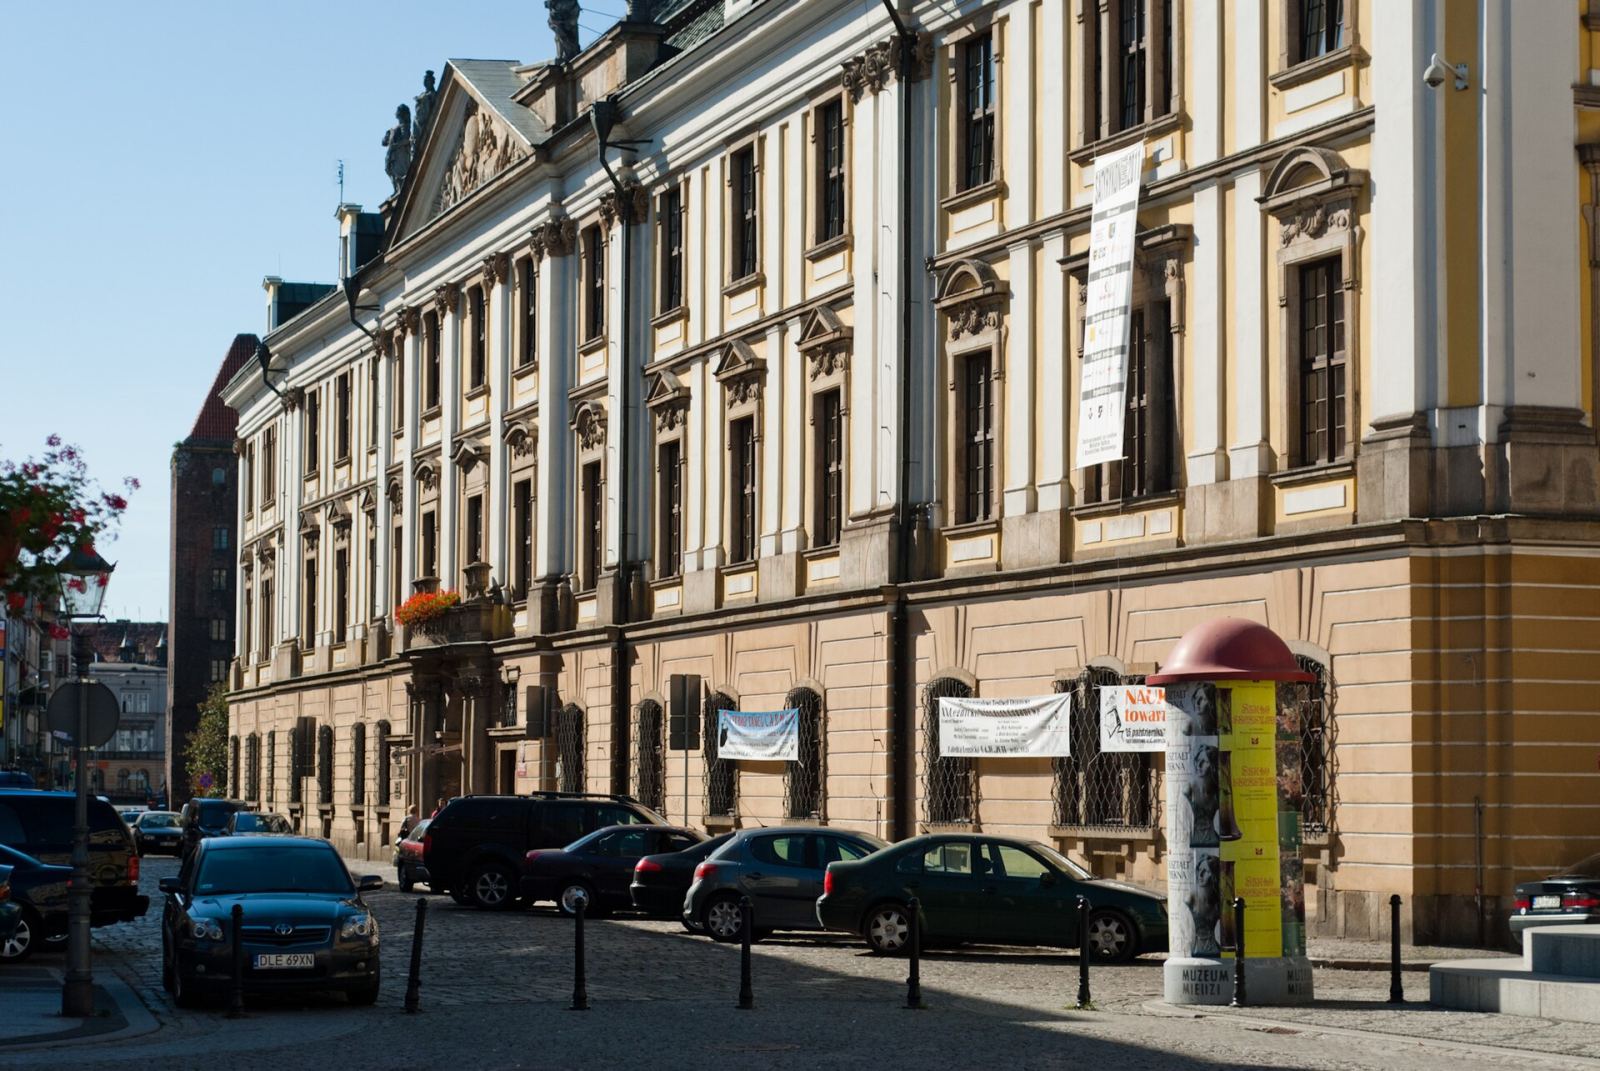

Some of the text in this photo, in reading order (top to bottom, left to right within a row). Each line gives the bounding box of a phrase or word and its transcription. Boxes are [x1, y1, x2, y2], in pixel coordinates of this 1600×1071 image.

[260, 954, 313, 966] DLE 69XN
[1182, 969, 1229, 982] MUZEUM
